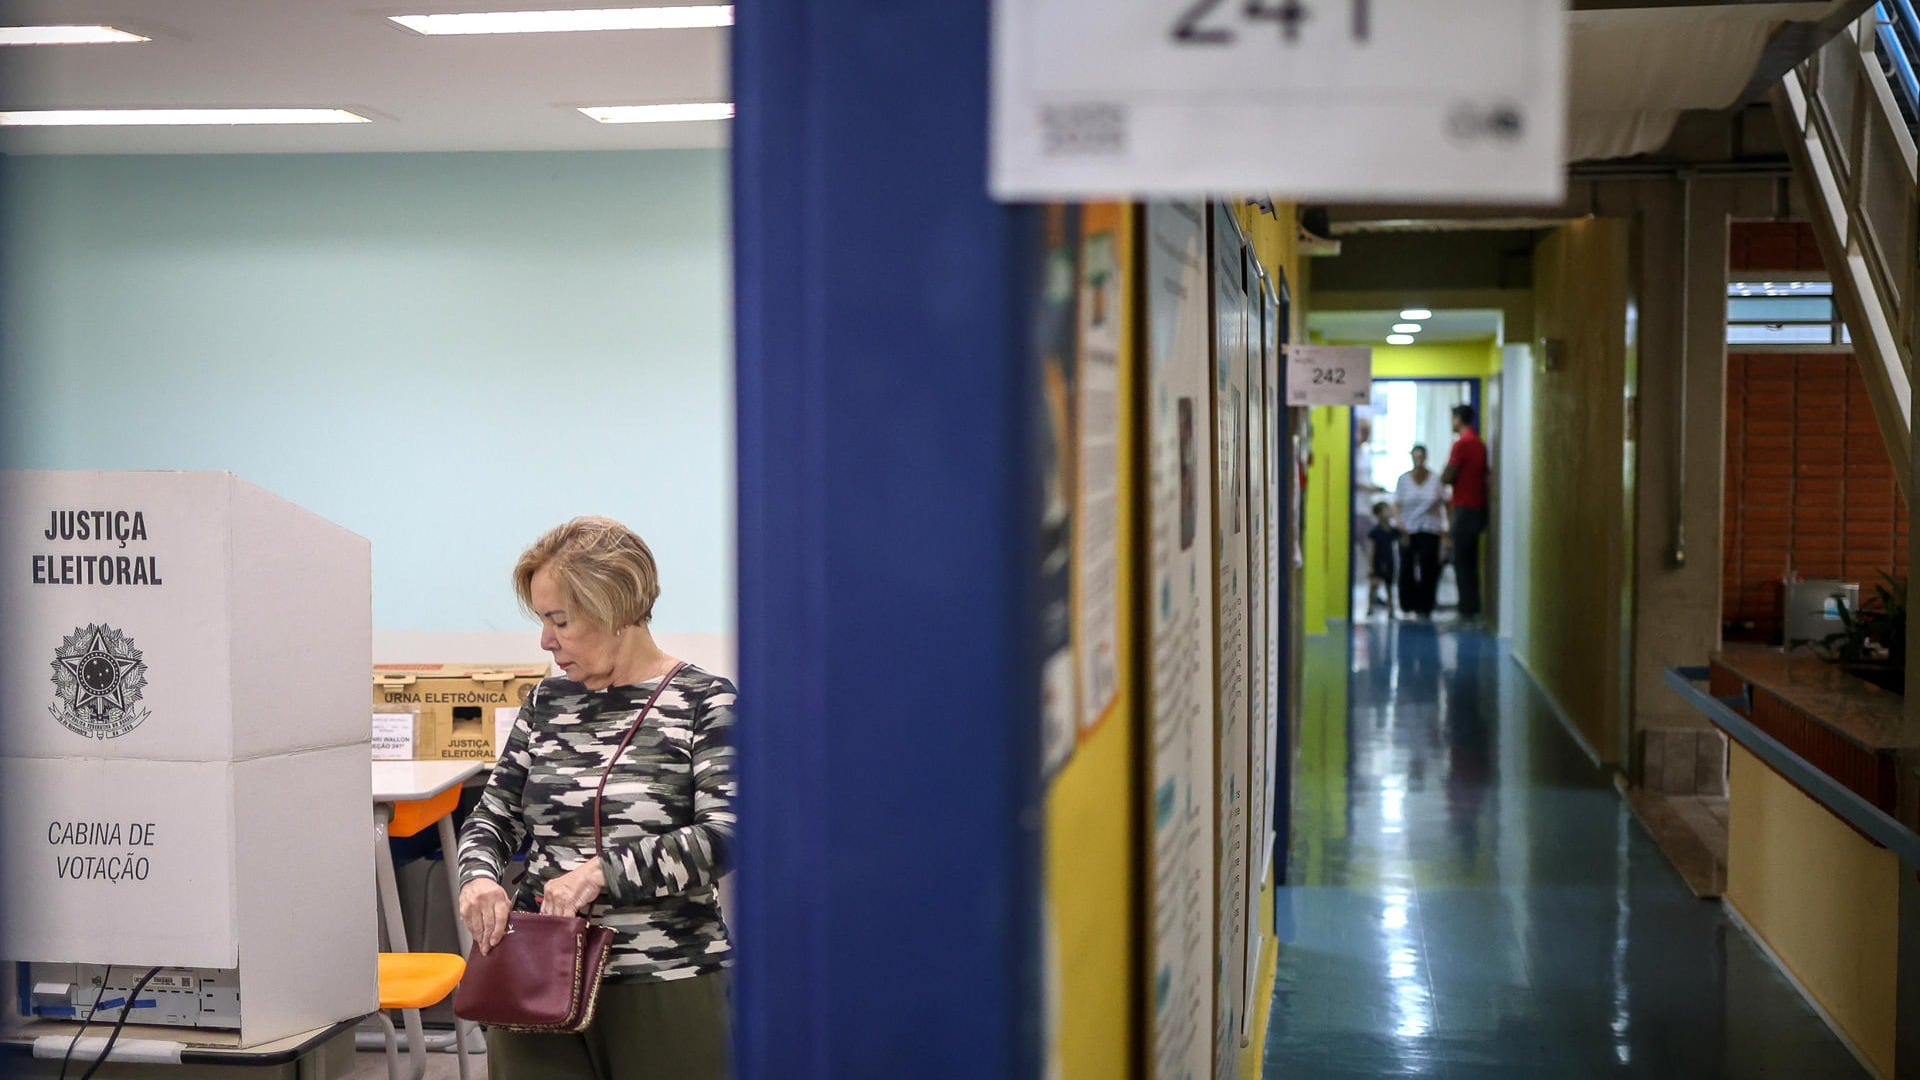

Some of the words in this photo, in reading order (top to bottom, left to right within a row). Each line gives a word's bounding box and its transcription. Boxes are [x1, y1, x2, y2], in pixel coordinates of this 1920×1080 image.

[1312, 367, 1346, 385] 242
[44, 510, 147, 549] JUSTIÇA
[32, 555, 162, 586] ELEITORAL
[384, 692, 421, 703] URNA
[425, 690, 507, 703] ELETRÔNICA
[441, 749, 496, 758] ELEITORAL
[448, 739, 490, 749] JUSTIÇA
[48, 821, 121, 846] CABINA
[128, 823, 156, 846] DE
[57, 852, 150, 884] VOTAÇÃO
